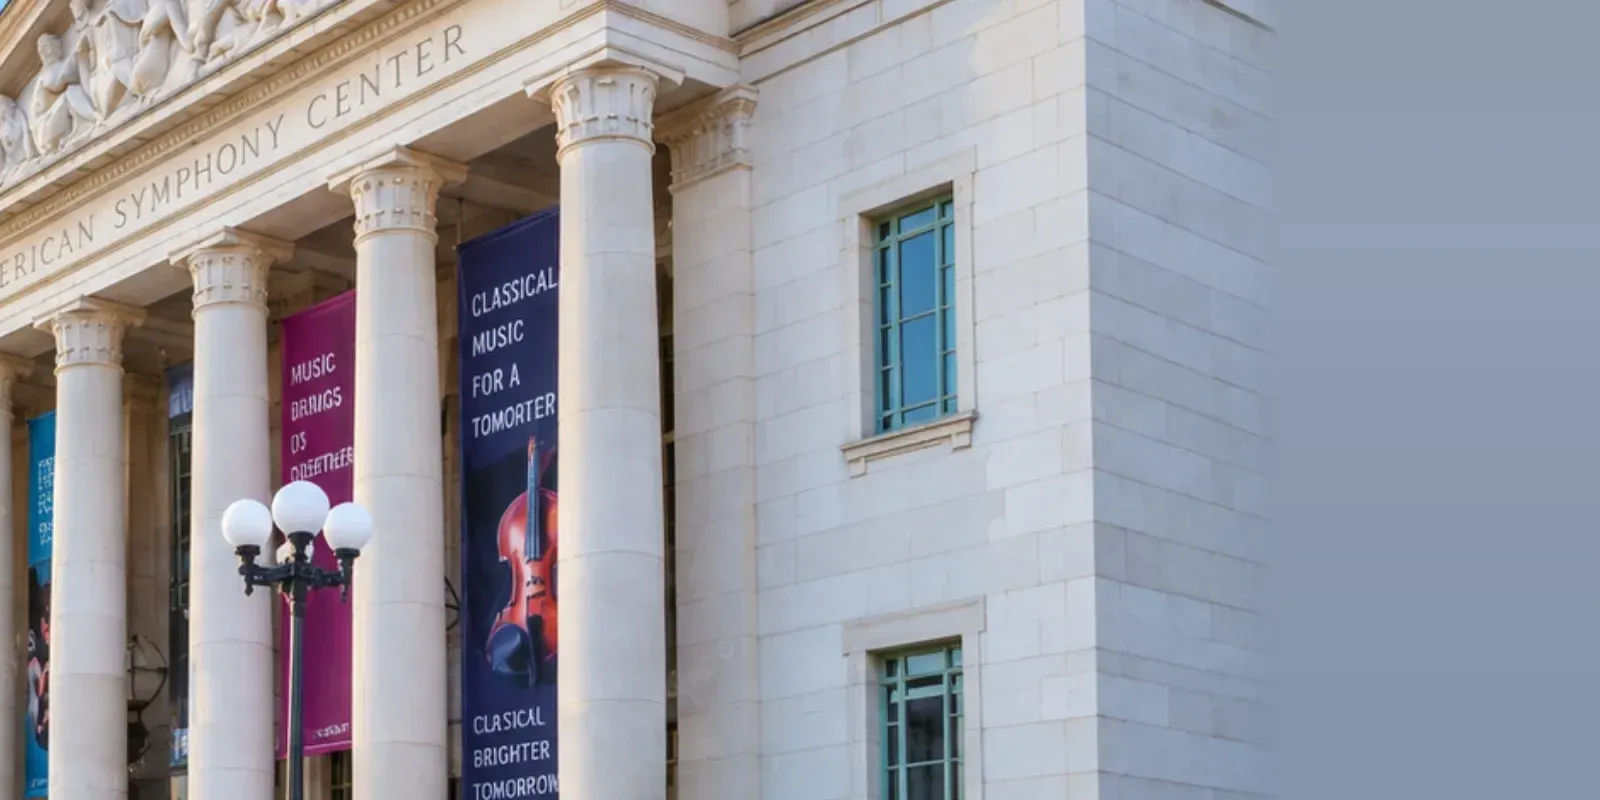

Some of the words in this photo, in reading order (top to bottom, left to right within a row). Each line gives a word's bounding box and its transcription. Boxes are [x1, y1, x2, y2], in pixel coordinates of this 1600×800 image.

[114, 113, 284, 229] SYMPHONY
[307, 24, 467, 129] CENTER
[472, 267, 557, 317] CLASSICAL
[472, 319, 524, 357] MUSIC
[291, 352, 336, 386] MUSIC
[472, 368, 504, 398] FOR
[509, 362, 520, 388] A
[472, 392, 556, 438] TOMORTER
[473, 740, 550, 768] BRIGHTER
